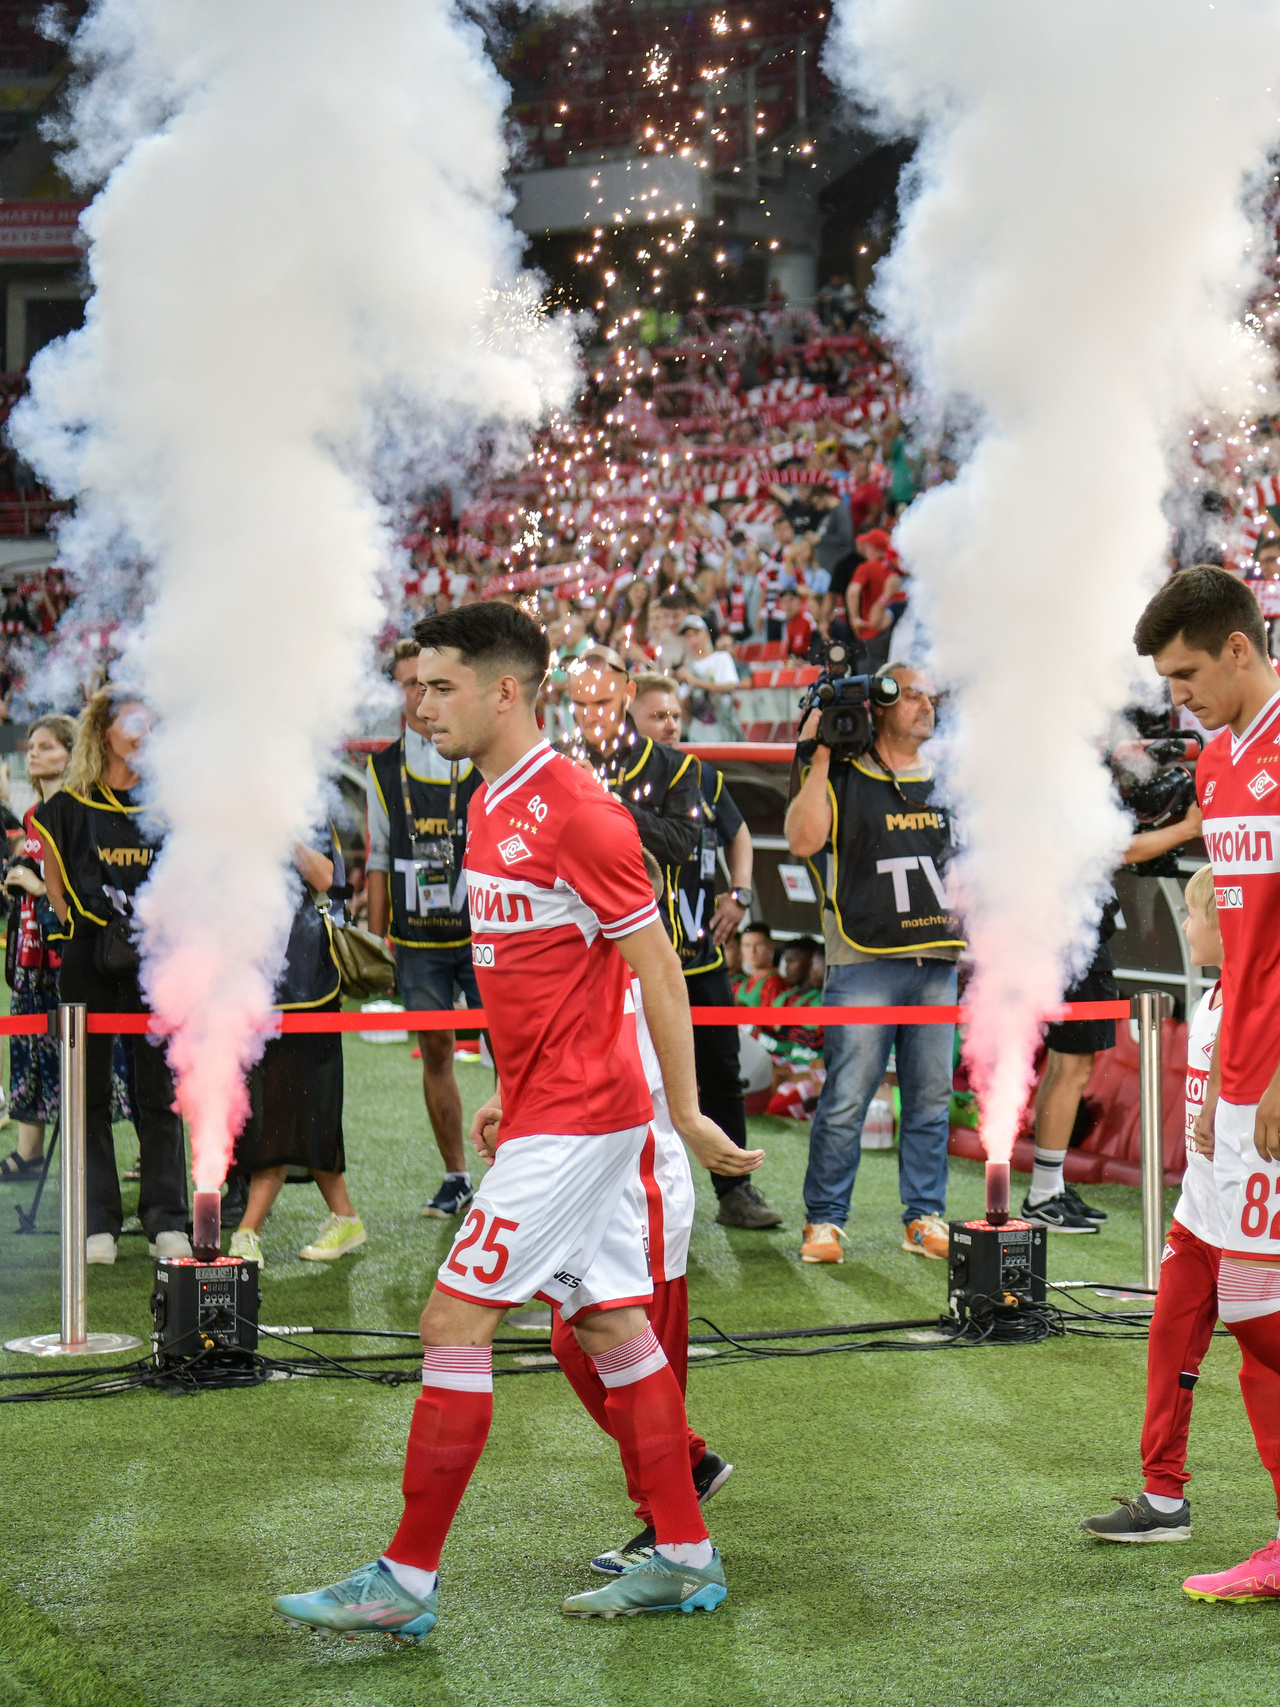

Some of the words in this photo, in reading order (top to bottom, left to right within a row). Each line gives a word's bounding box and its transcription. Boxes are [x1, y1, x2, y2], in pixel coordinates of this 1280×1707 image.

[527, 794, 548, 823] BQ
[1204, 823, 1274, 863] УКОЙЛ
[901, 914, 959, 929] matchtv.ru
[447, 1208, 520, 1285] 25
